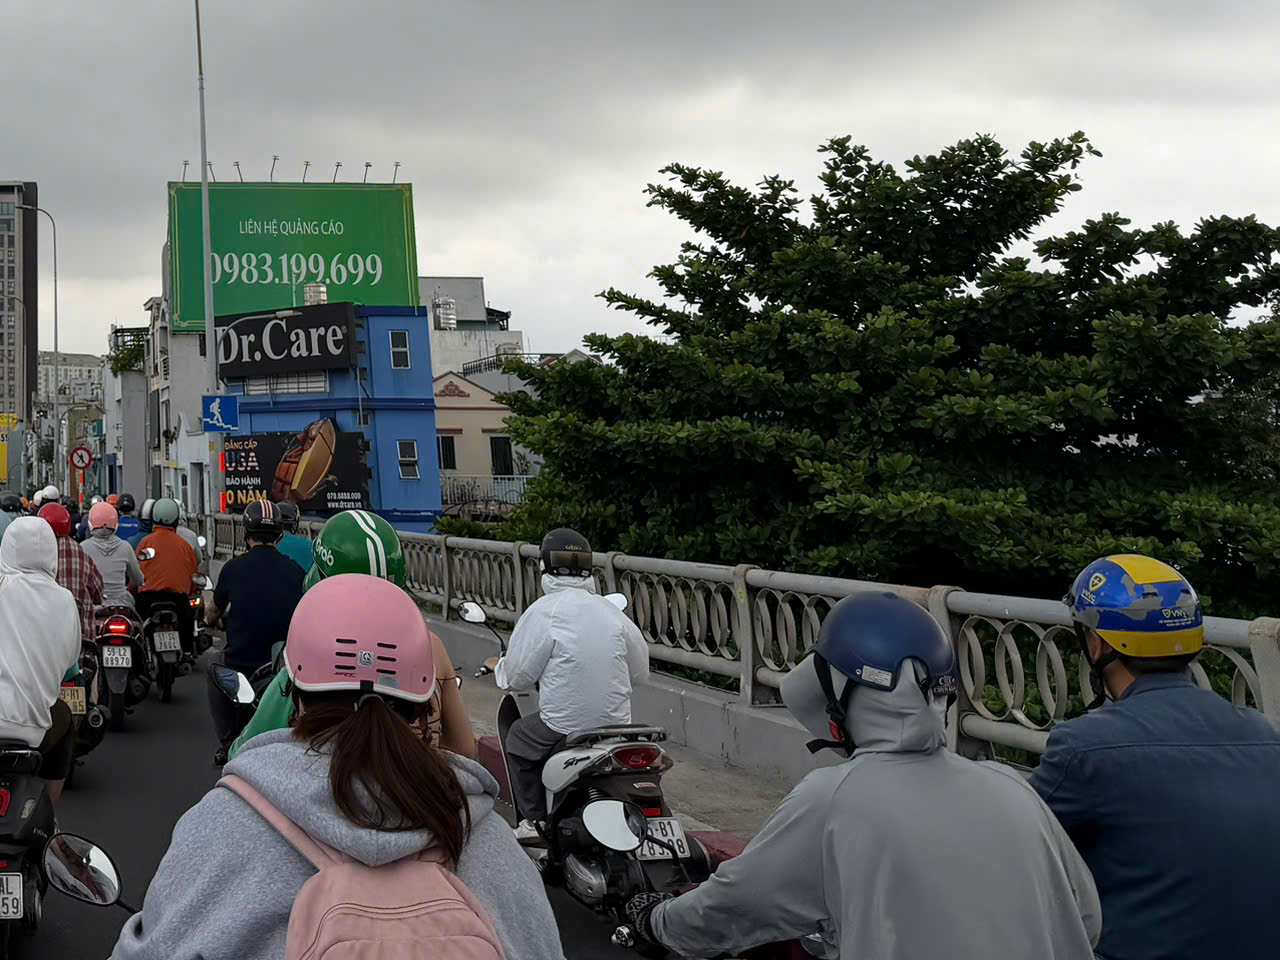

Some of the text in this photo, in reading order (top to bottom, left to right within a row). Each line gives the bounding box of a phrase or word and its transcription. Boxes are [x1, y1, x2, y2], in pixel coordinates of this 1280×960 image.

[239, 217, 344, 237] LIÊN HỆ QUẢNG CÁO
[211, 252, 383, 286] 0983.199.699
[225, 452, 259, 471] USA
[225, 475, 261, 486] BẢO HÀNH
[237, 485, 267, 505] NĂM
[107, 647, 127, 657] 59-L2
